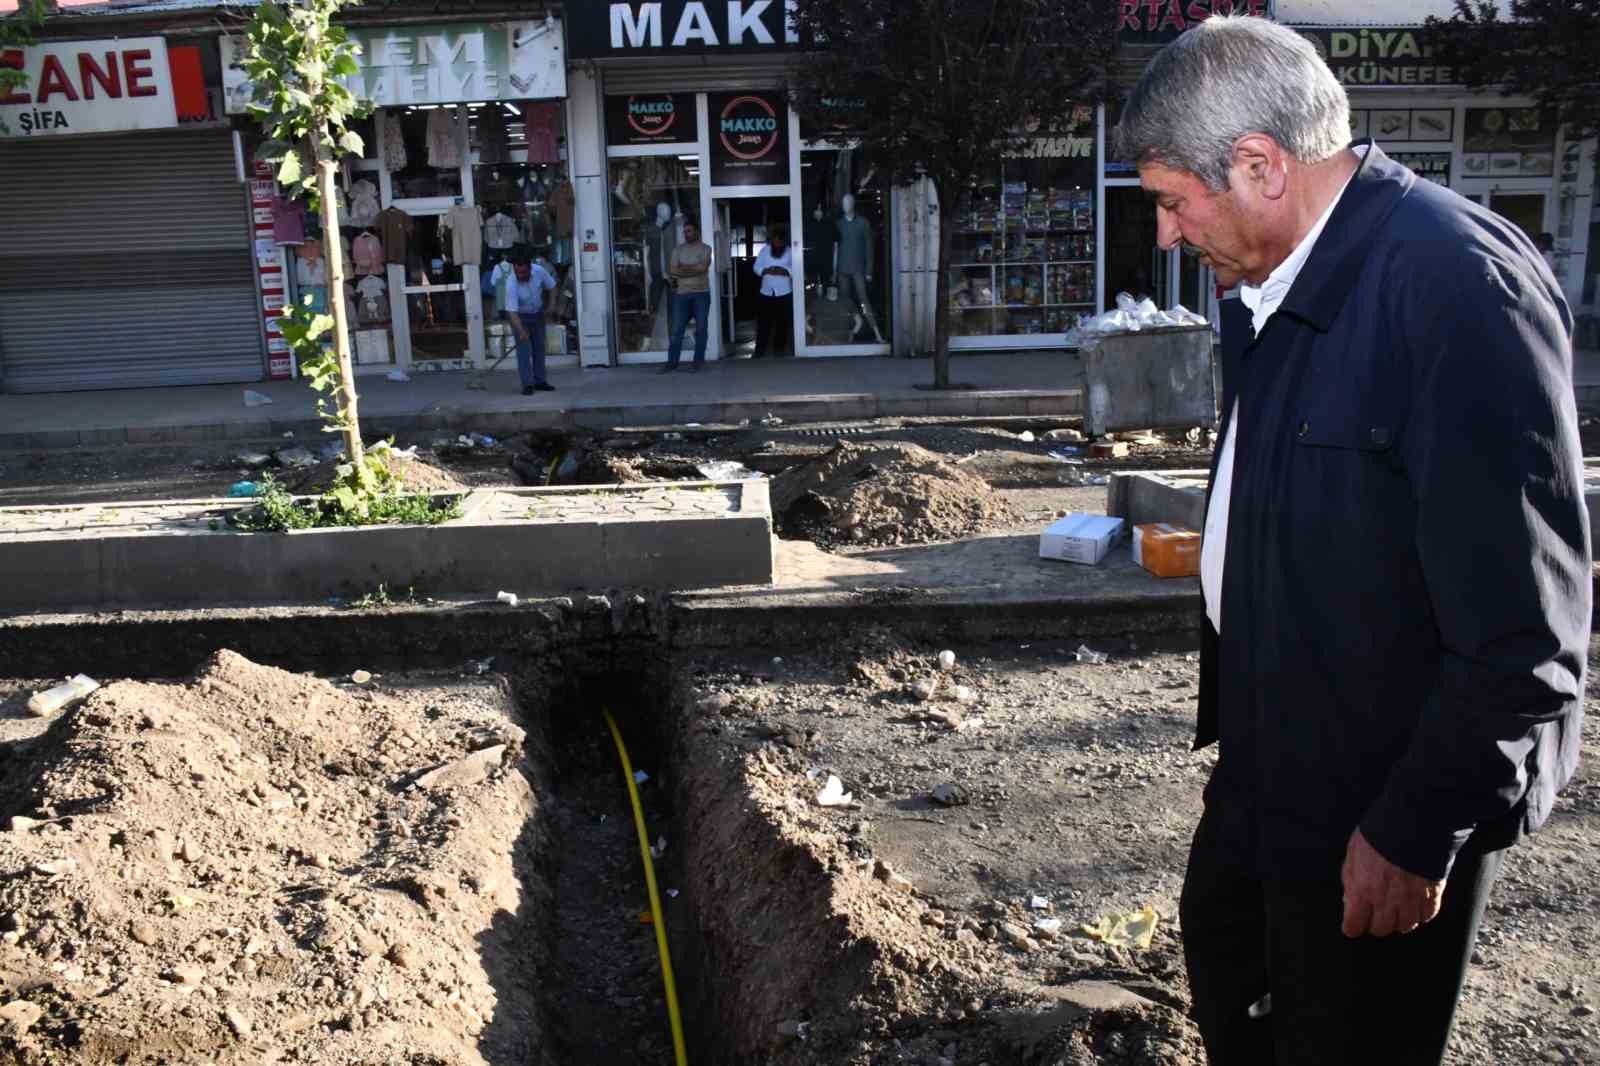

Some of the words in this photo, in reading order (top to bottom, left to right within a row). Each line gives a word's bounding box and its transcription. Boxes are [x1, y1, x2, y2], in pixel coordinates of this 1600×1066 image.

[1330, 29, 1433, 58] DİYA
[1338, 61, 1453, 84] KÜNEFE
[628, 102, 674, 115] MAKKO
[19, 108, 69, 135] ŞİFA
[720, 118, 777, 132] MAKKO
